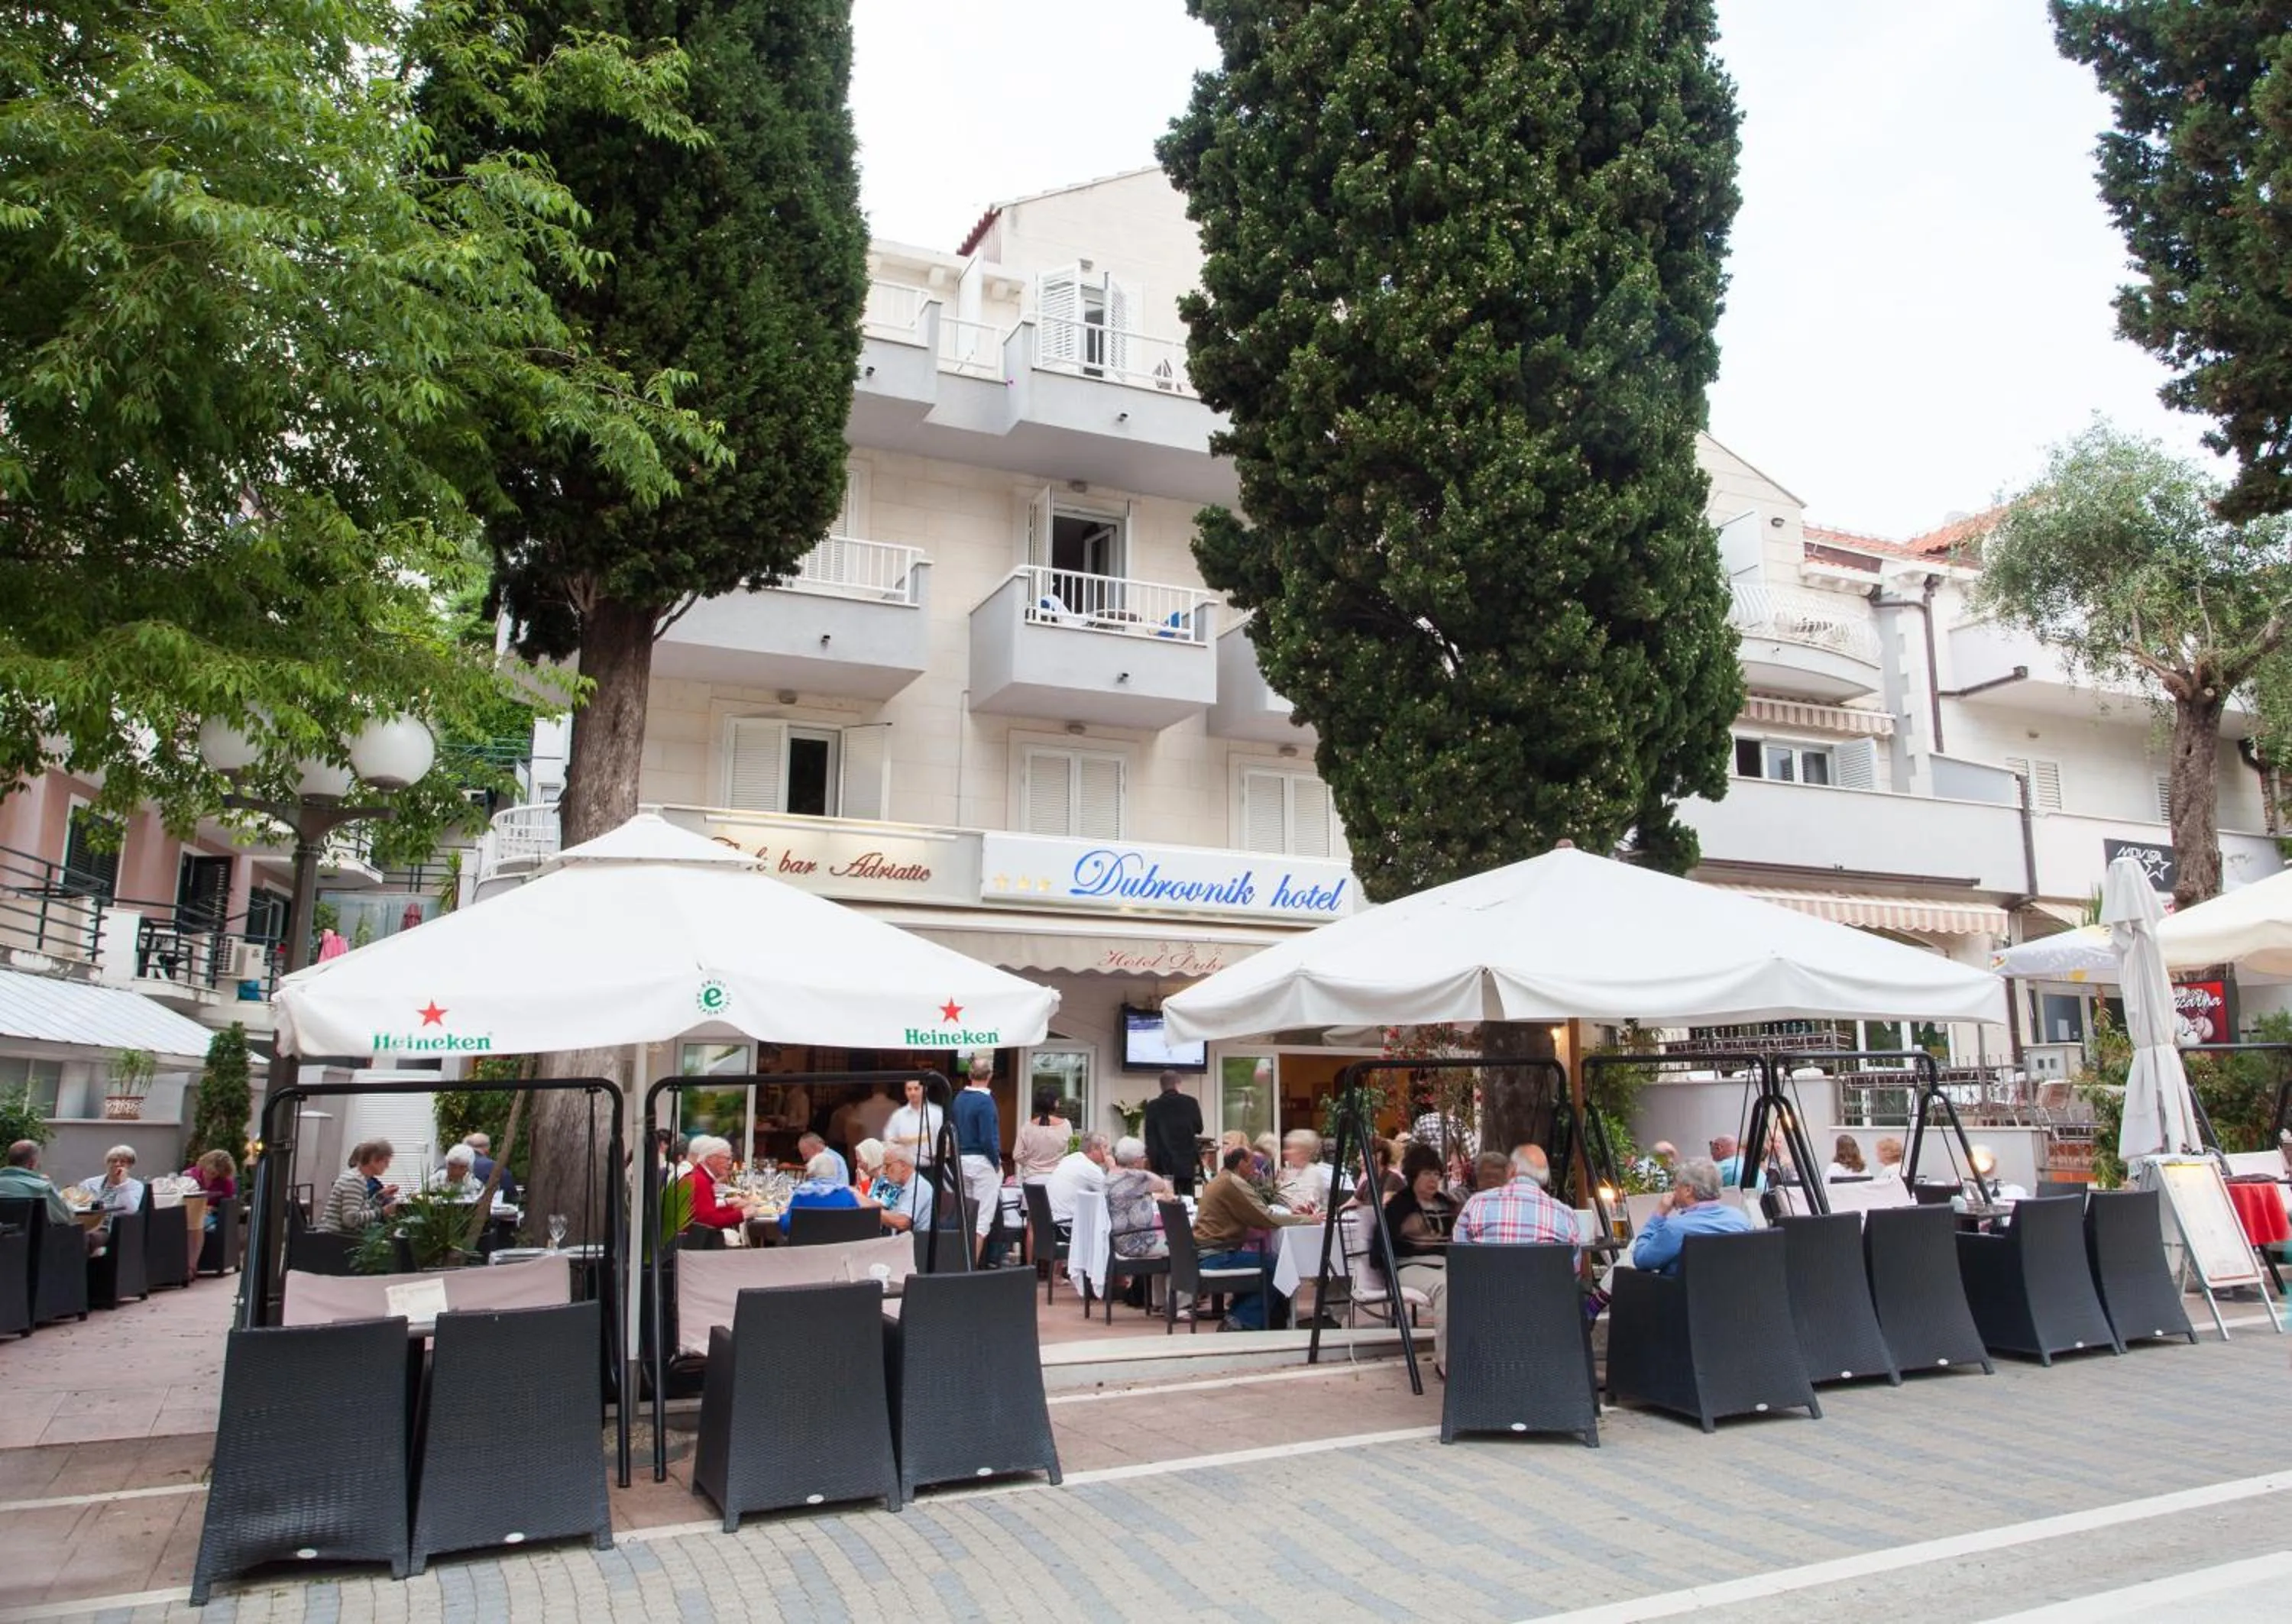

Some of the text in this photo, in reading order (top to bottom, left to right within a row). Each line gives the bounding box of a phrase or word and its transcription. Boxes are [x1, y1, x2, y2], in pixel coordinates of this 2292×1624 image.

[779, 849, 817, 875] bar
[1069, 849, 1346, 911] Dubrovnik hotel
[1098, 949, 1165, 968] Hotel
[373, 1032, 491, 1051] Heineken
[905, 1028, 999, 1046] Heineken
